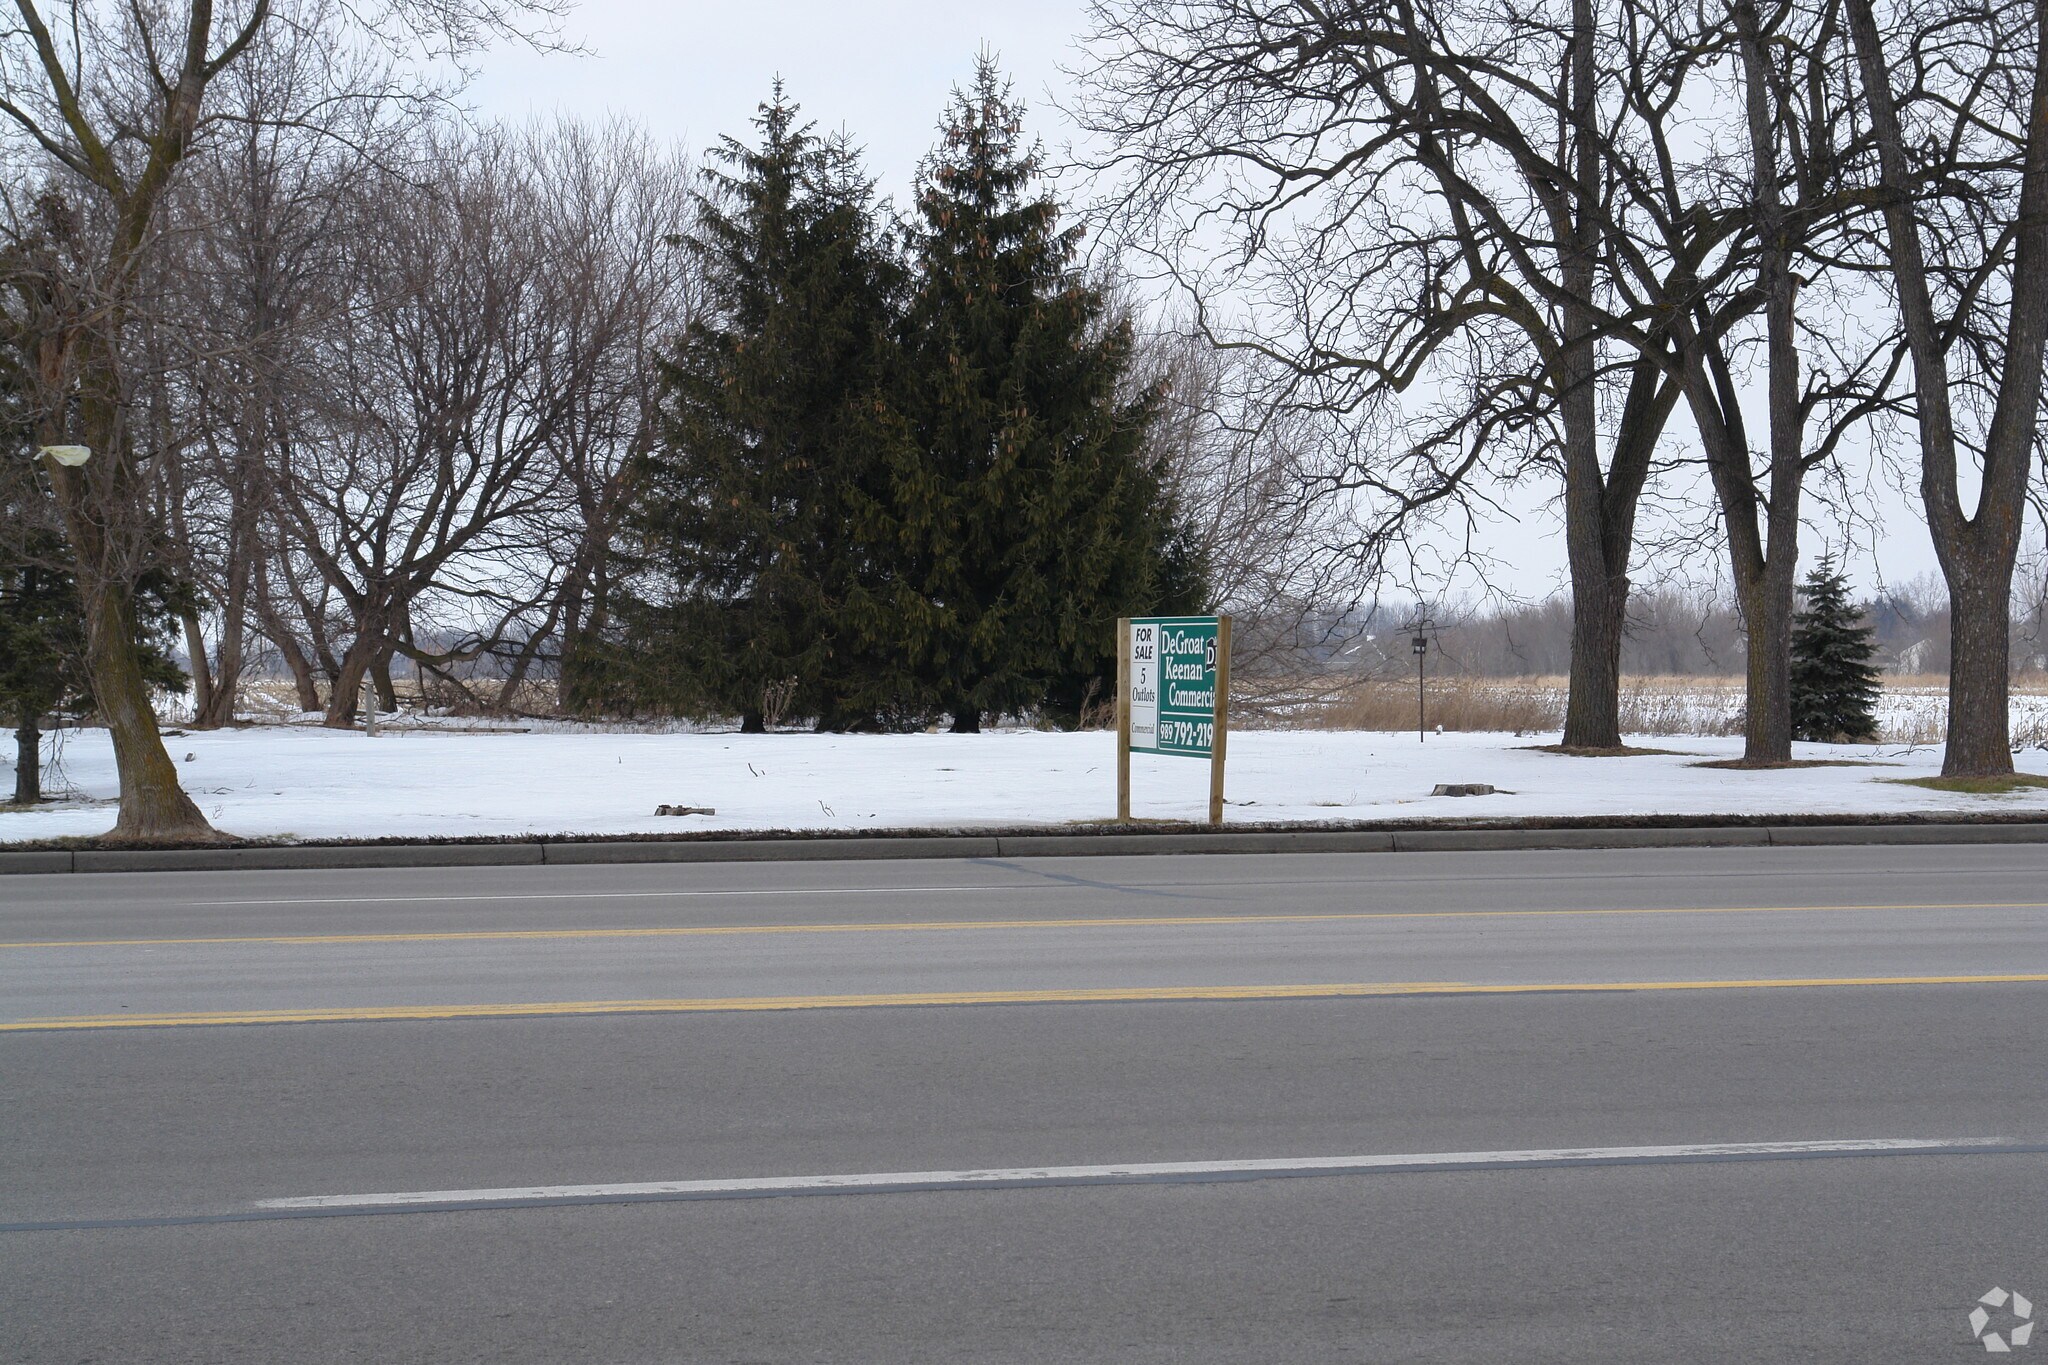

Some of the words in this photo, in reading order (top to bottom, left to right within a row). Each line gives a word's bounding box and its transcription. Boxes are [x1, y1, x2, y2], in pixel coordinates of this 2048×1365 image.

[1136, 628, 1152, 641] FOR
[1162, 630, 1204, 654] DeGroat
[1135, 645, 1153, 659] SALE
[1207, 646, 1217, 664] D
[1140, 667, 1146, 684] 5
[1165, 656, 1203, 680] Keenan
[1132, 687, 1155, 702] Outlots
[1160, 723, 1173, 740] 989
